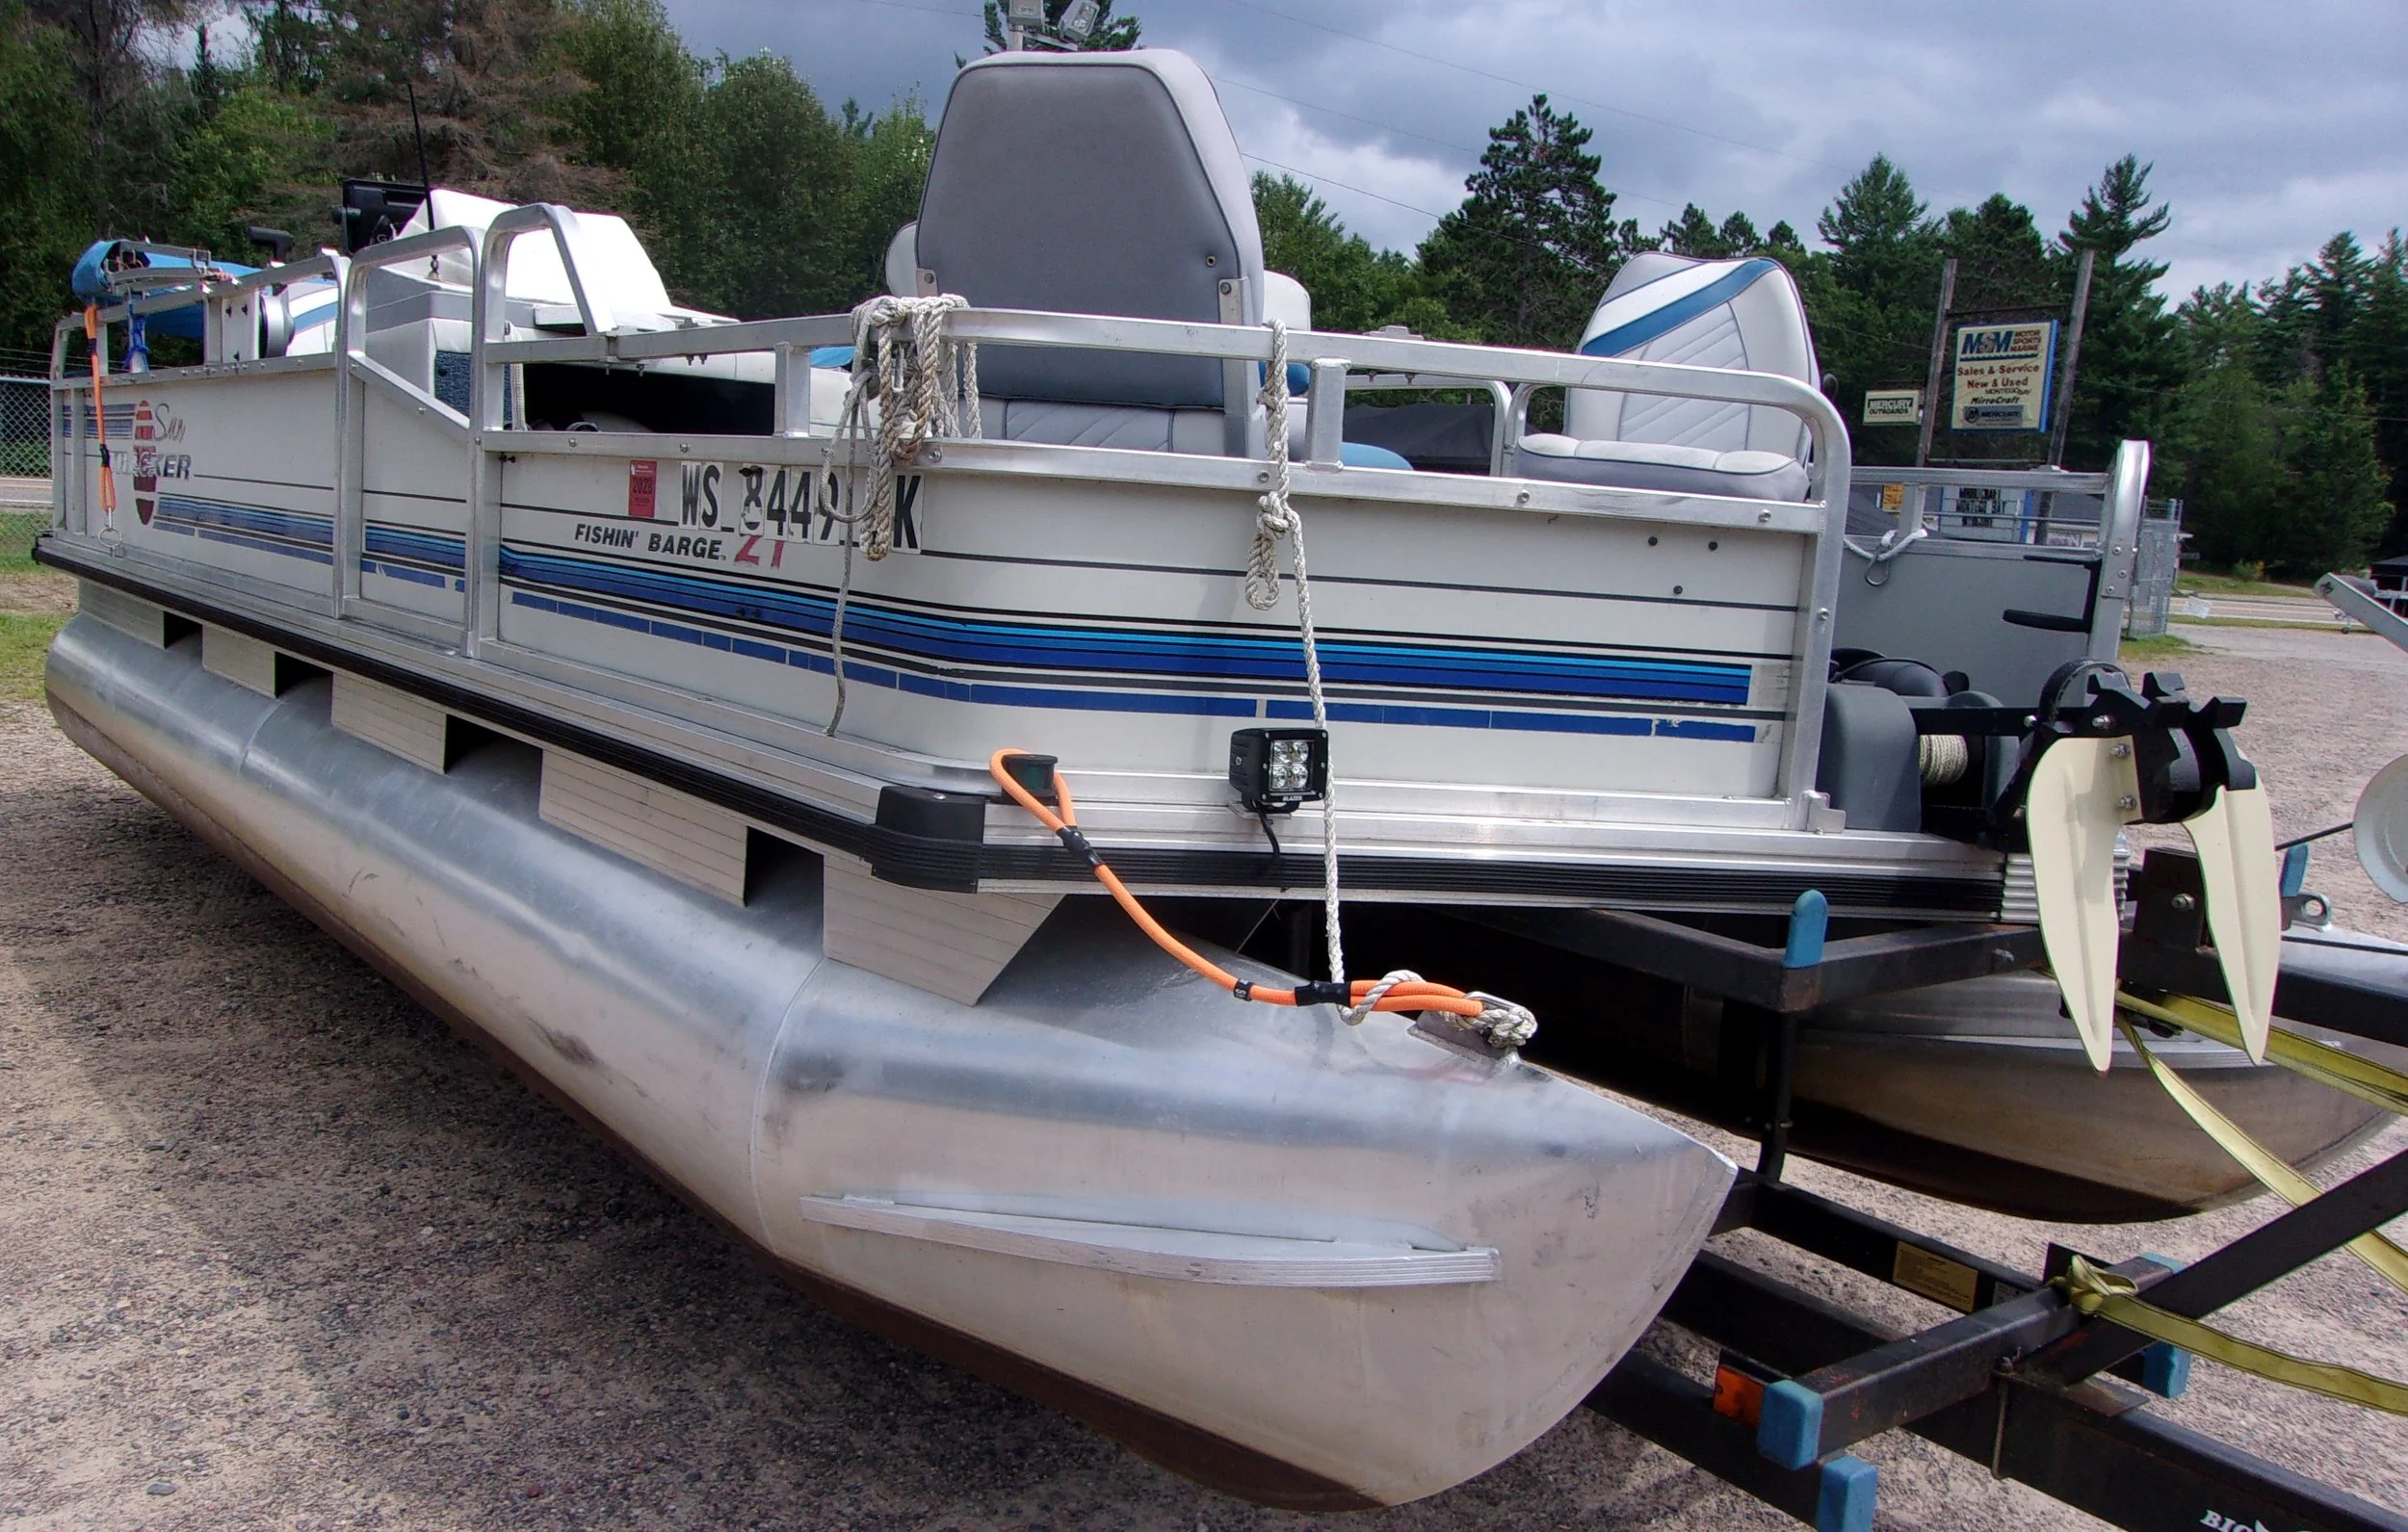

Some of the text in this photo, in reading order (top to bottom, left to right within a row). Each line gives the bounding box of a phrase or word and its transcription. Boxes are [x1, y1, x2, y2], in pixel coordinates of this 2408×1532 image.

[1957, 364, 2040, 377] Sales & Service
[1967, 377, 2028, 389] New & Used
[1870, 400, 1912, 408] MERCURY
[682, 463, 720, 529] WS
[574, 523, 639, 549] FISHIN'
[647, 532, 722, 560] BARGE
